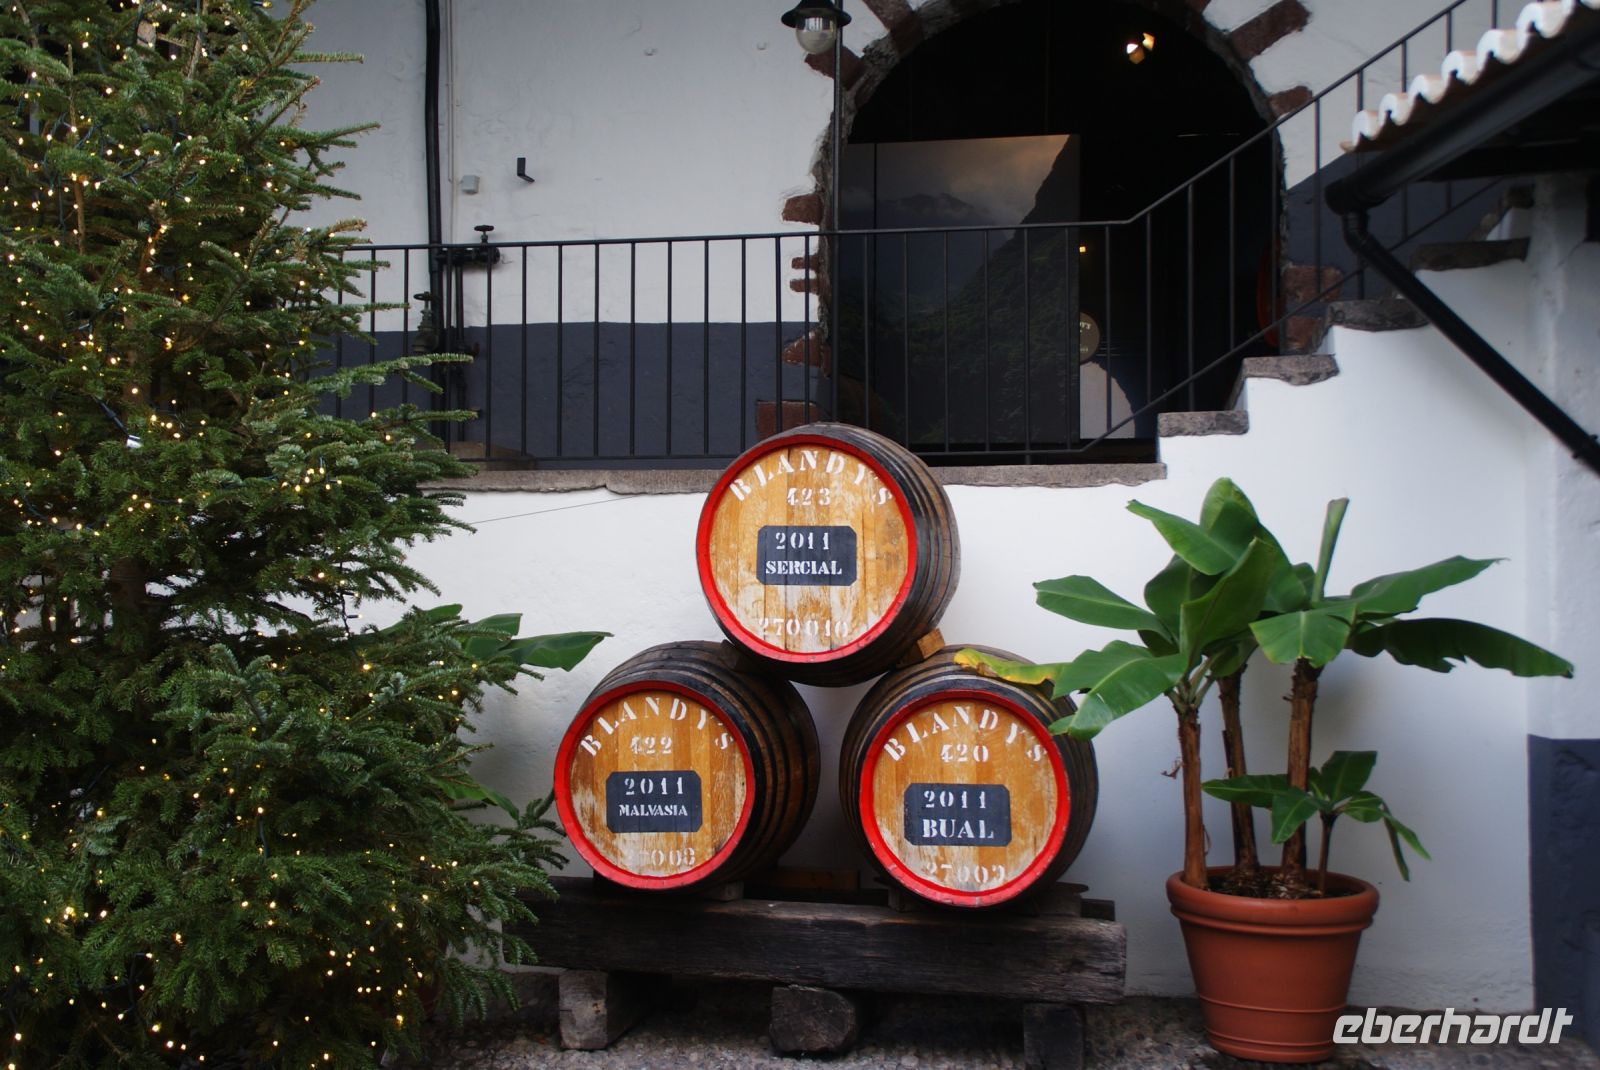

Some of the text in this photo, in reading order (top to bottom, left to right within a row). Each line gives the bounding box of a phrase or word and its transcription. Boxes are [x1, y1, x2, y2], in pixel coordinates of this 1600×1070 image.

[786, 487, 831, 506] 423
[775, 532, 830, 550] 2011
[765, 560, 842, 576] SERCIAL
[940, 743, 989, 763] 420
[624, 777, 684, 796] 2011
[923, 790, 986, 809] 2011
[619, 804, 688, 817] MALVASIA
[922, 818, 994, 839] BUAL
